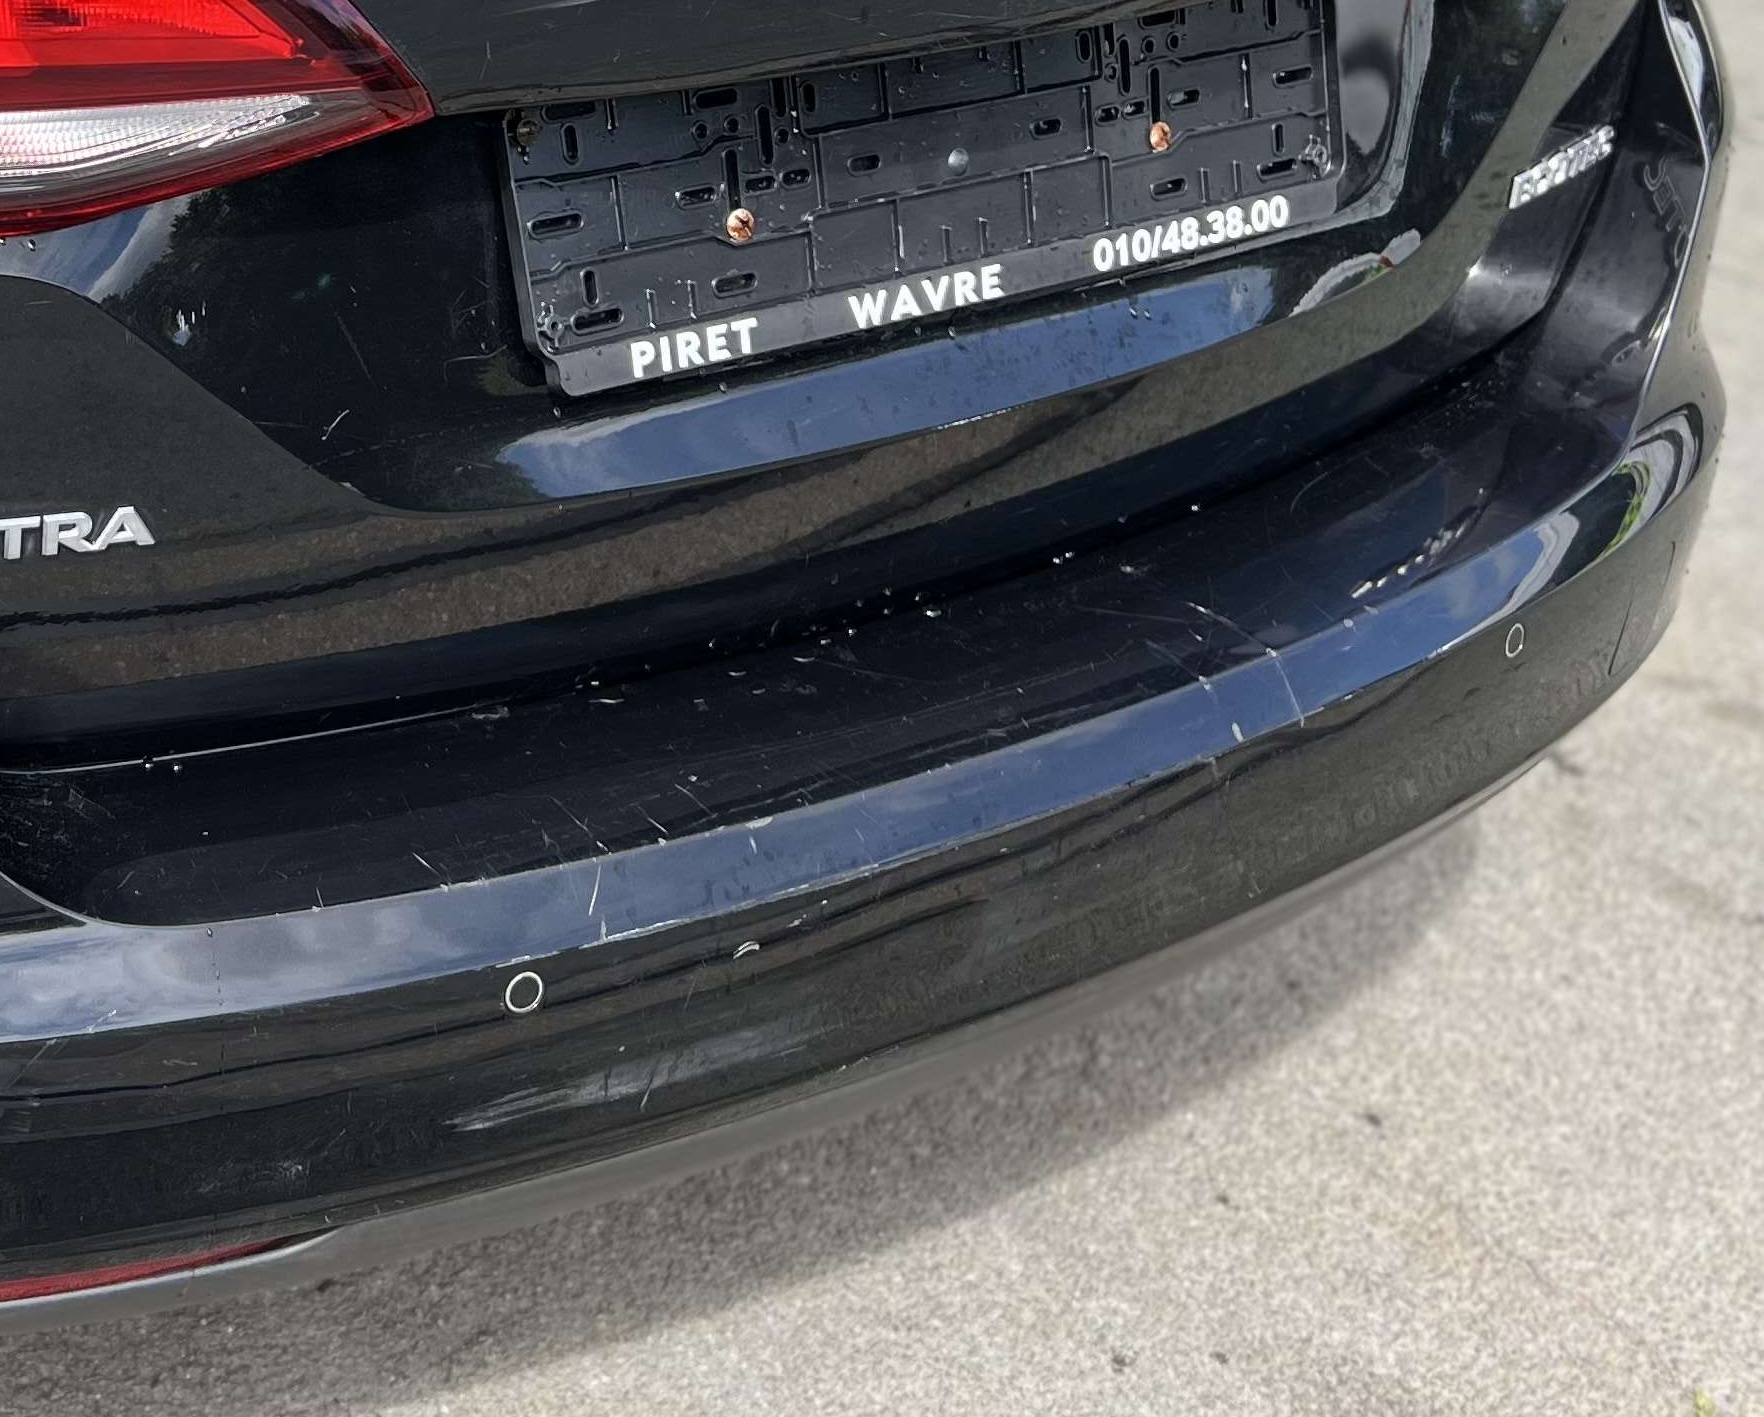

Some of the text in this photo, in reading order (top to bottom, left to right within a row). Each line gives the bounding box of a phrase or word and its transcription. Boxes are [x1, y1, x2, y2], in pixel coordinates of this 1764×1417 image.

[629, 194, 1291, 380] PIRET WAVRE 010/48.38.00
